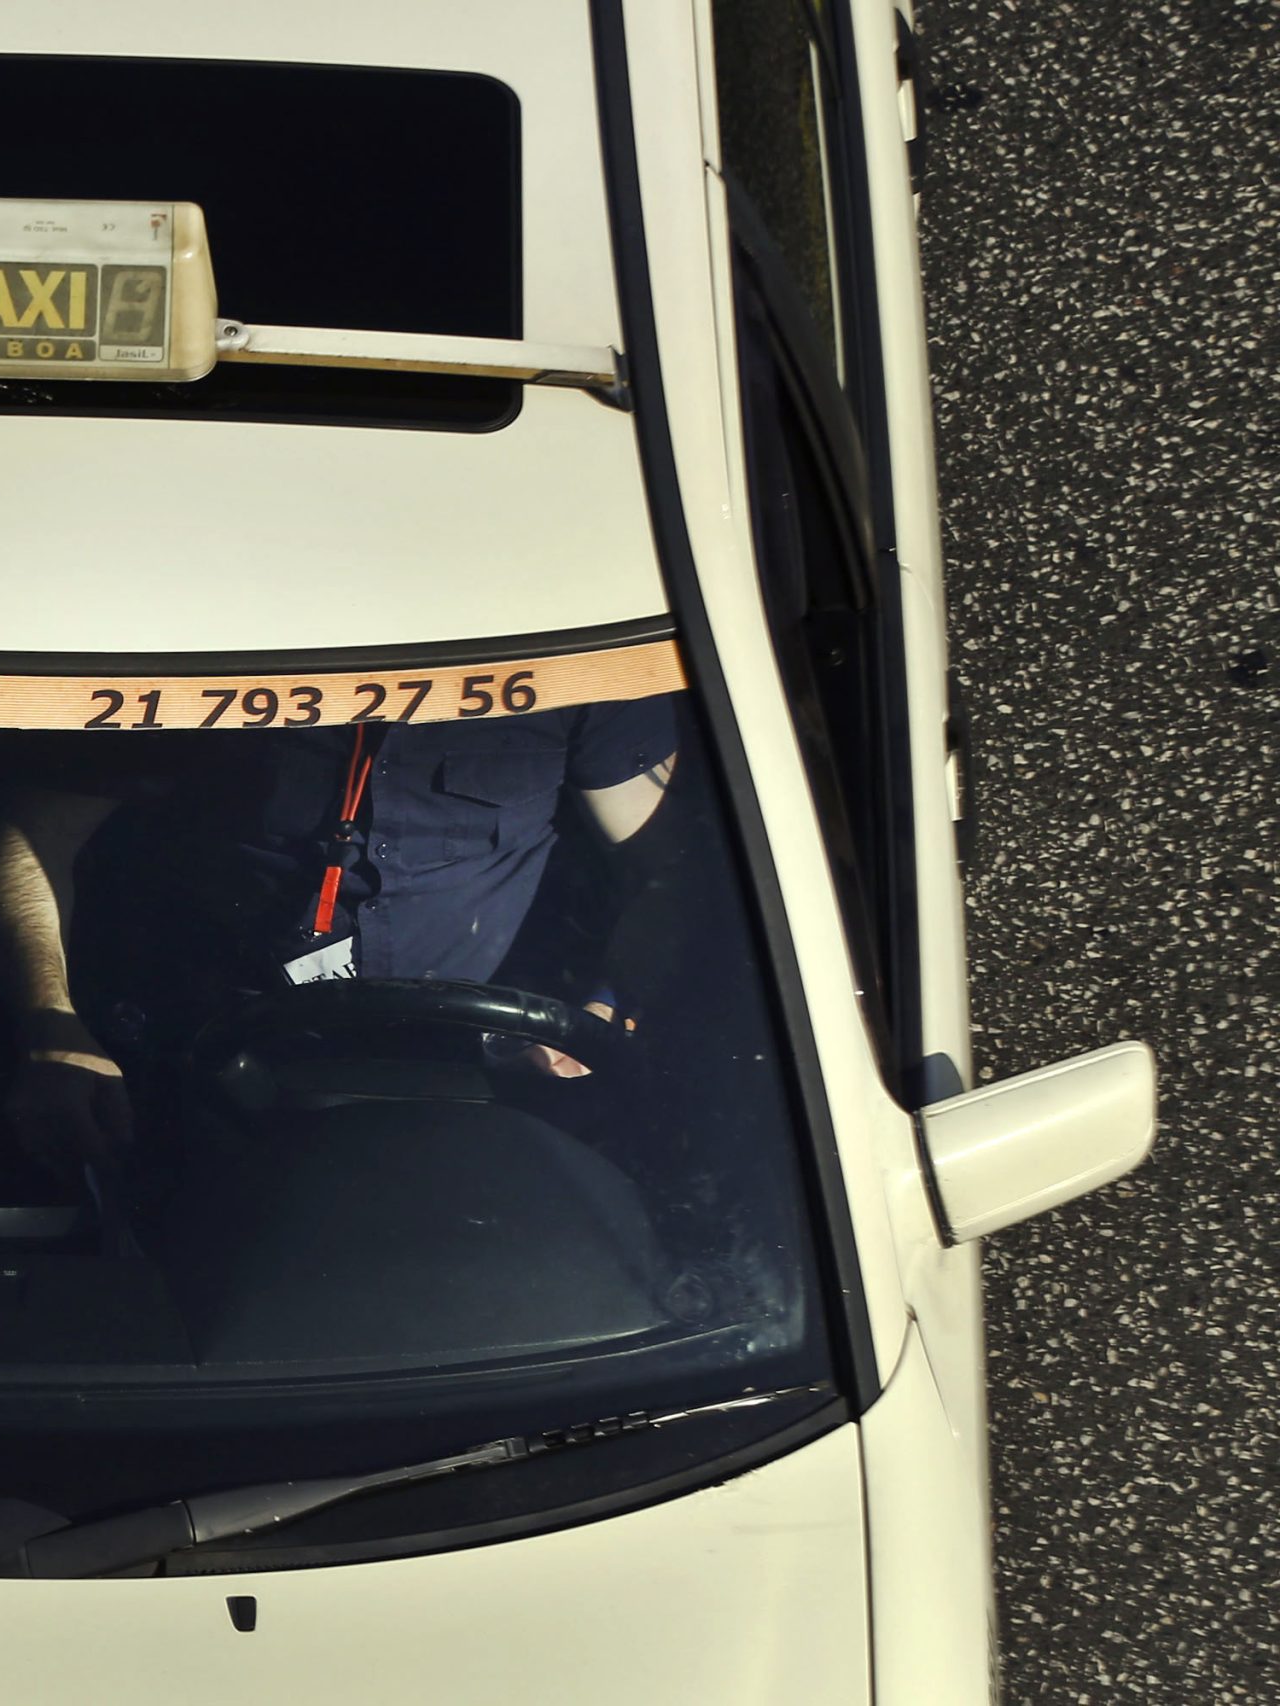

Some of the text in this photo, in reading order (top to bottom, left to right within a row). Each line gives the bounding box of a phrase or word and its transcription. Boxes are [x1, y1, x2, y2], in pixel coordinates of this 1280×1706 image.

[84, 671, 538, 729] 21 793 27 56
